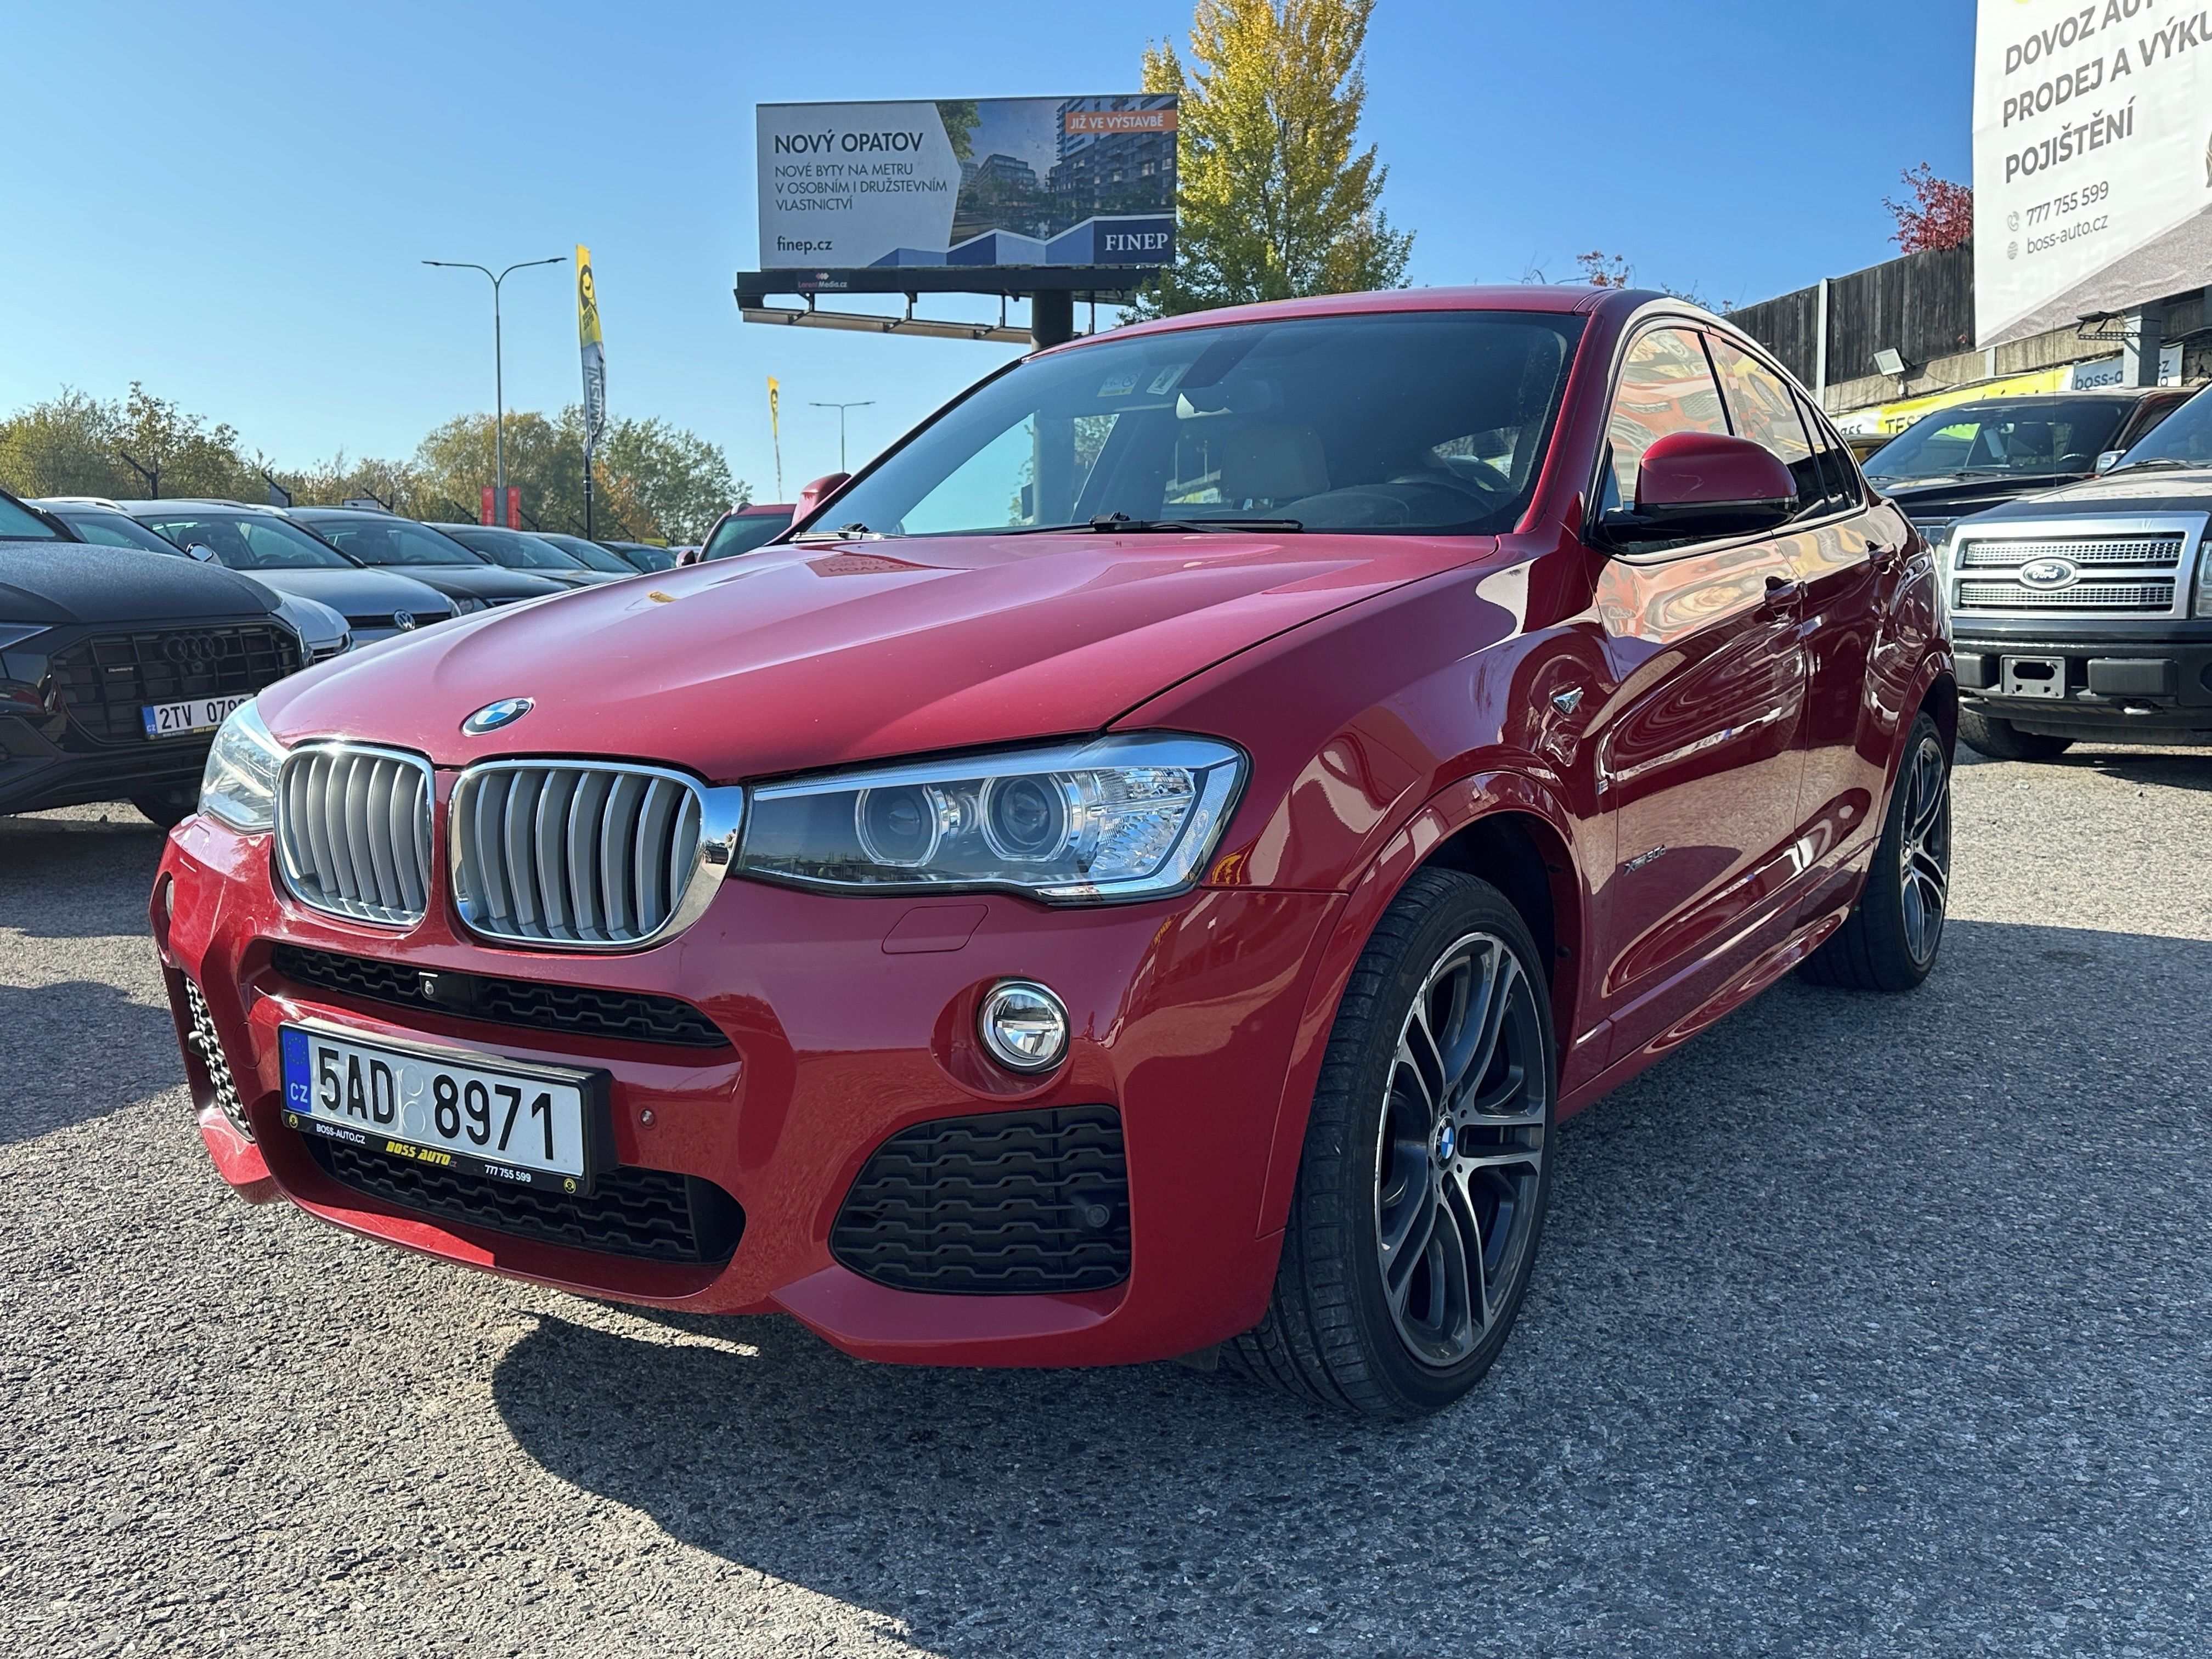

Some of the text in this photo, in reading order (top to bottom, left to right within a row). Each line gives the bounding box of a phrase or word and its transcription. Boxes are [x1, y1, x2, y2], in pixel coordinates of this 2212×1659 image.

[2005, 0, 2153, 76] DOVOZ AU
[2003, 57, 2104, 128] PRODEJ
[2110, 47, 2132, 82] A
[1070, 113, 1164, 129] JIŽ VE VÝSTAVBĚ
[775, 128, 924, 154] NOVÝ OPATOV
[2005, 95, 2137, 184] POJIŠTĚNÍ
[775, 162, 913, 178] NOVÉ BYTY NA METRU
[775, 177, 948, 194] V OSOBNÍM I DRUŽSTEVNÍM
[775, 195, 854, 211] VLASTNICTVÍ
[2027, 181, 2109, 226] 777 755 599
[777, 235, 833, 255] finep.cz
[1105, 233, 1169, 251] FINEP
[2027, 215, 2108, 255] boss-auto.cz
[146, 724, 156, 732] CZ
[159, 704, 192, 730] 2TV
[290, 1082, 308, 1104] CZ
[318, 1046, 554, 1161] 5AD 8971
[316, 1124, 365, 1144] BOSS-AUTO.CZ
[386, 1141, 416, 1158] BOSS
[417, 1149, 451, 1166] AUTO
[484, 1164, 531, 1182] 777 755 599
